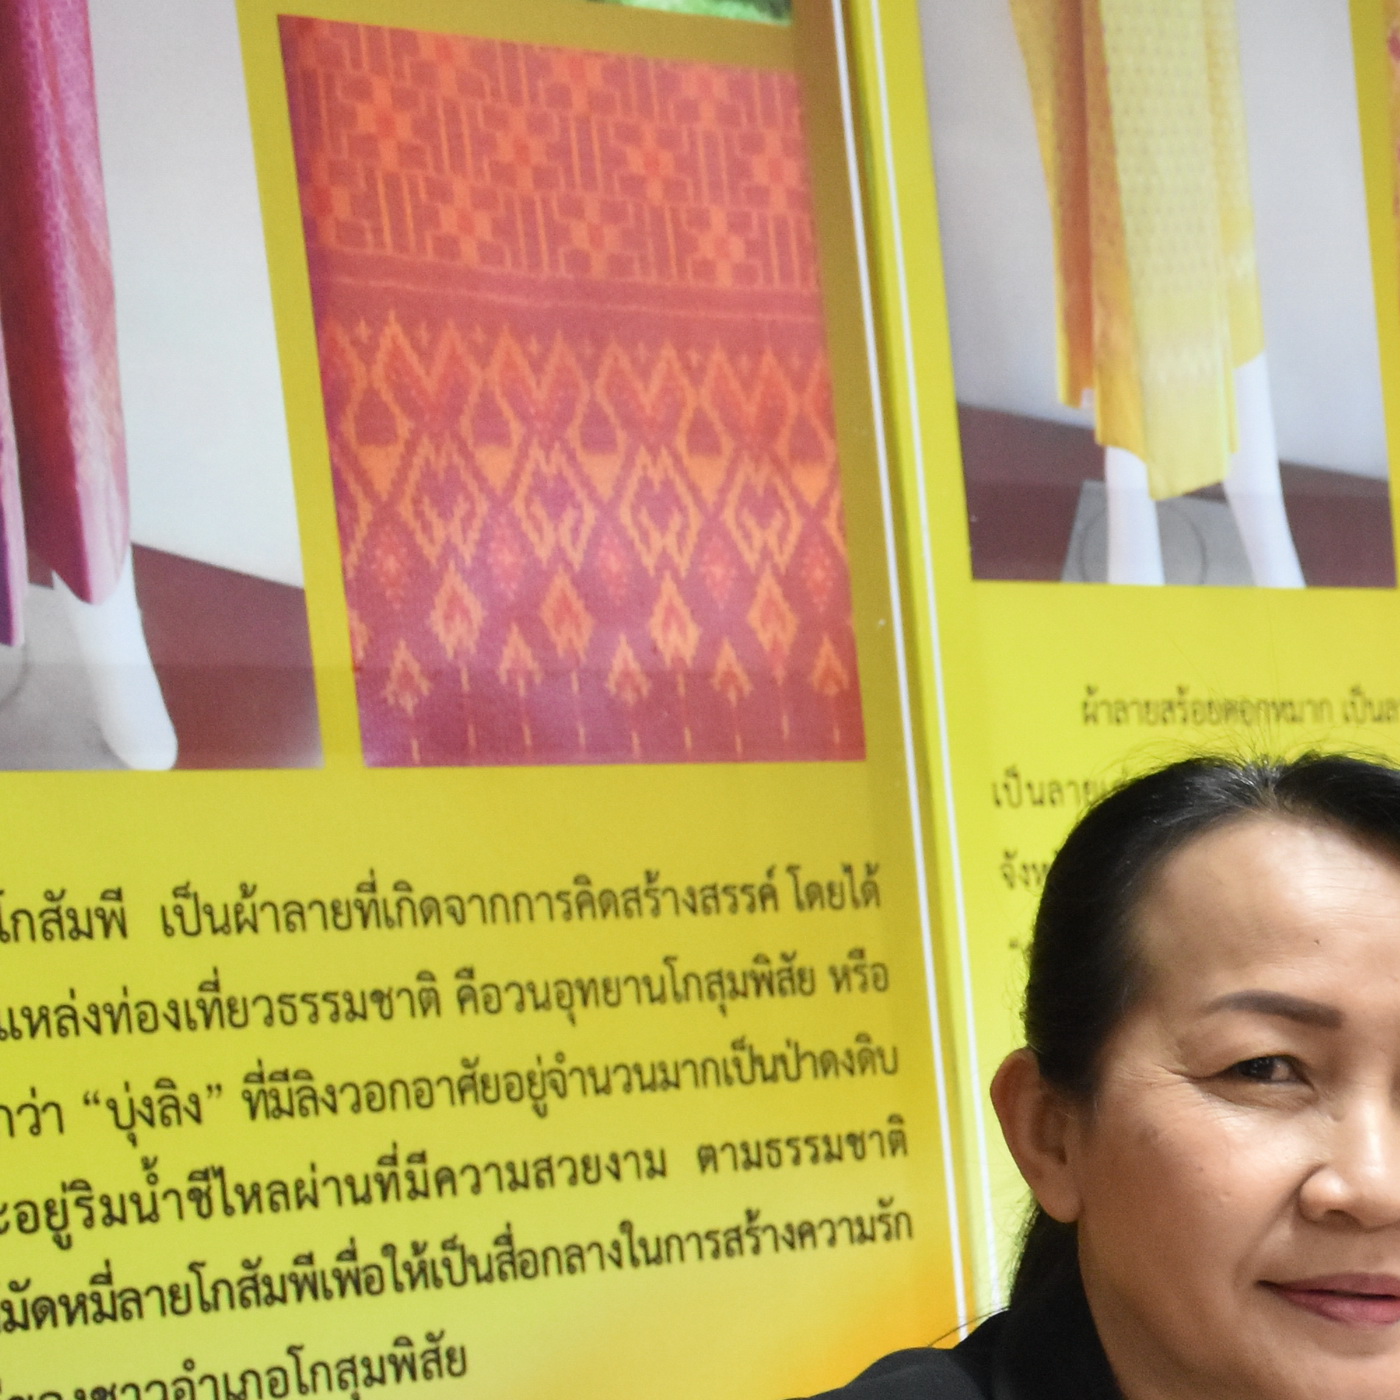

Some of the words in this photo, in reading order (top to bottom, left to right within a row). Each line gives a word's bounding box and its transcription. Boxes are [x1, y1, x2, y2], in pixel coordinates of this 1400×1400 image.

[160, 864, 780, 939] เป็นผ้าลายที่เกิดจากการคิดสร้างสรรค์
[785, 862, 882, 912] โดยได้
[454, 950, 816, 1027] คือวนอุทยานโกสุมพิสัย
[828, 946, 890, 995] หรือ
[240, 1031, 899, 1122] ที่มีลิงวอกอาศัยอยู่จำนวนมากเป็นป่าดงดิบ
[697, 1113, 909, 1175] ตามธรรมชาติ
